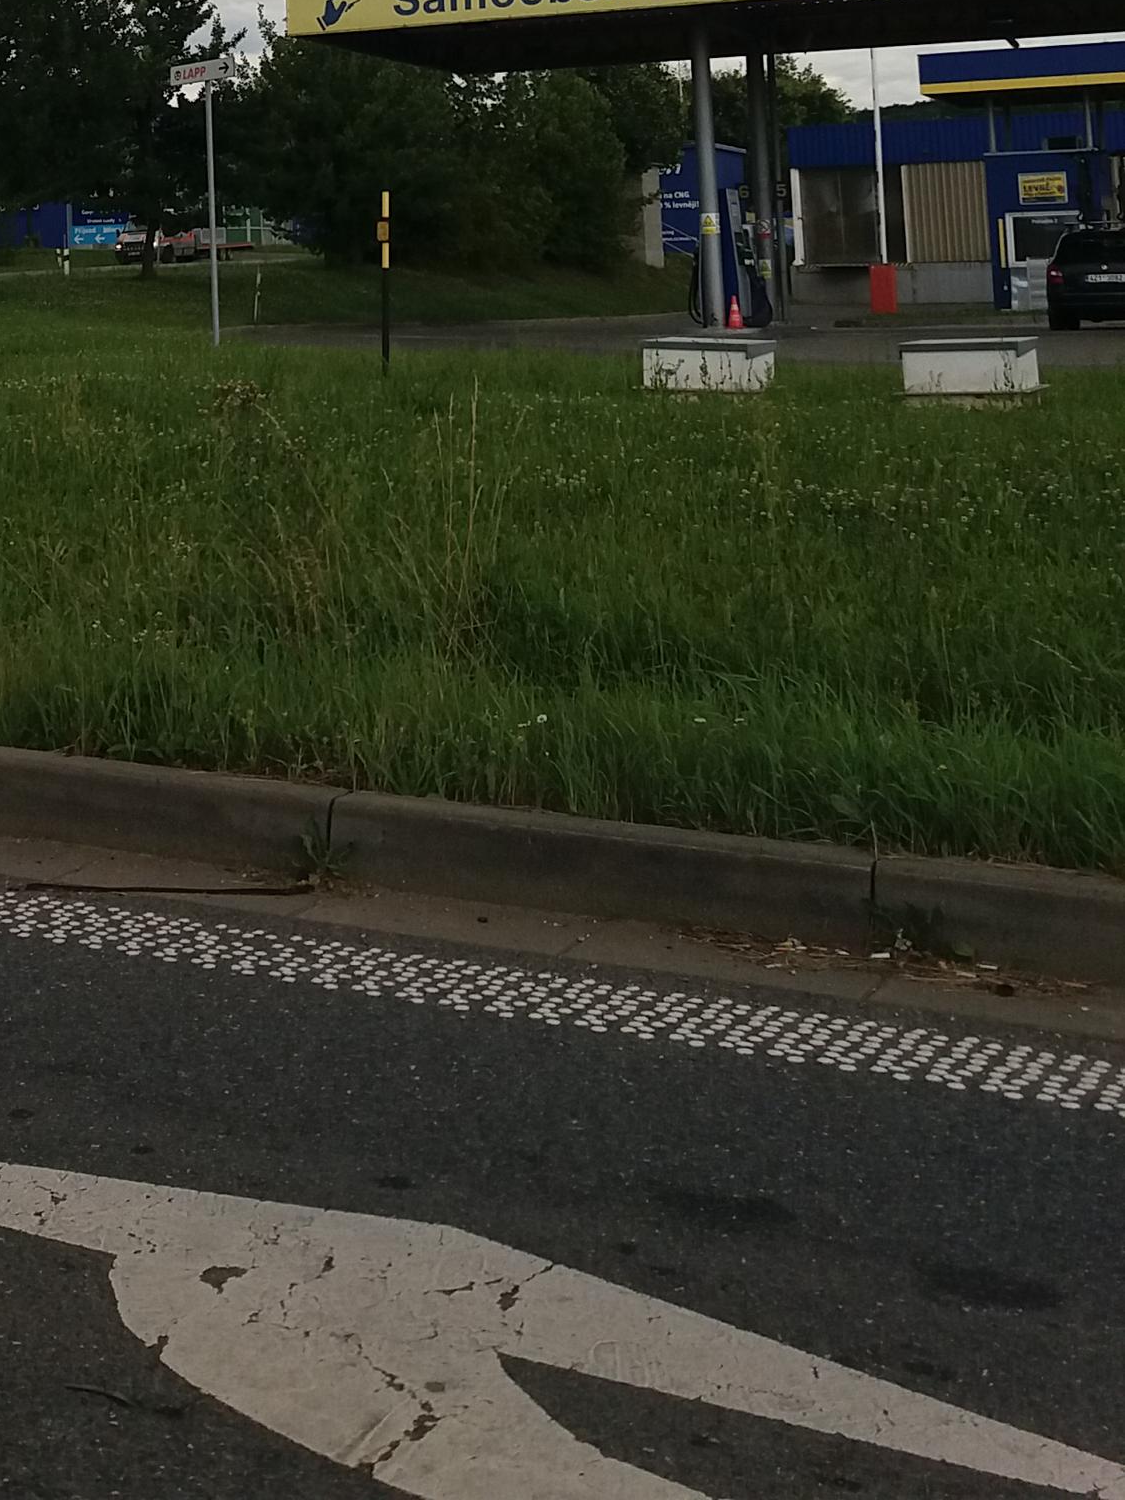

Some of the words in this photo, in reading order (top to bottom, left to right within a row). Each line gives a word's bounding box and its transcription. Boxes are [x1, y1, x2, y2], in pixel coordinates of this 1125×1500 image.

[182, 66, 206, 80] LAPP
[674, 191, 690, 199] CNG
[739, 185, 750, 198] 6
[776, 184, 787, 197] 5
